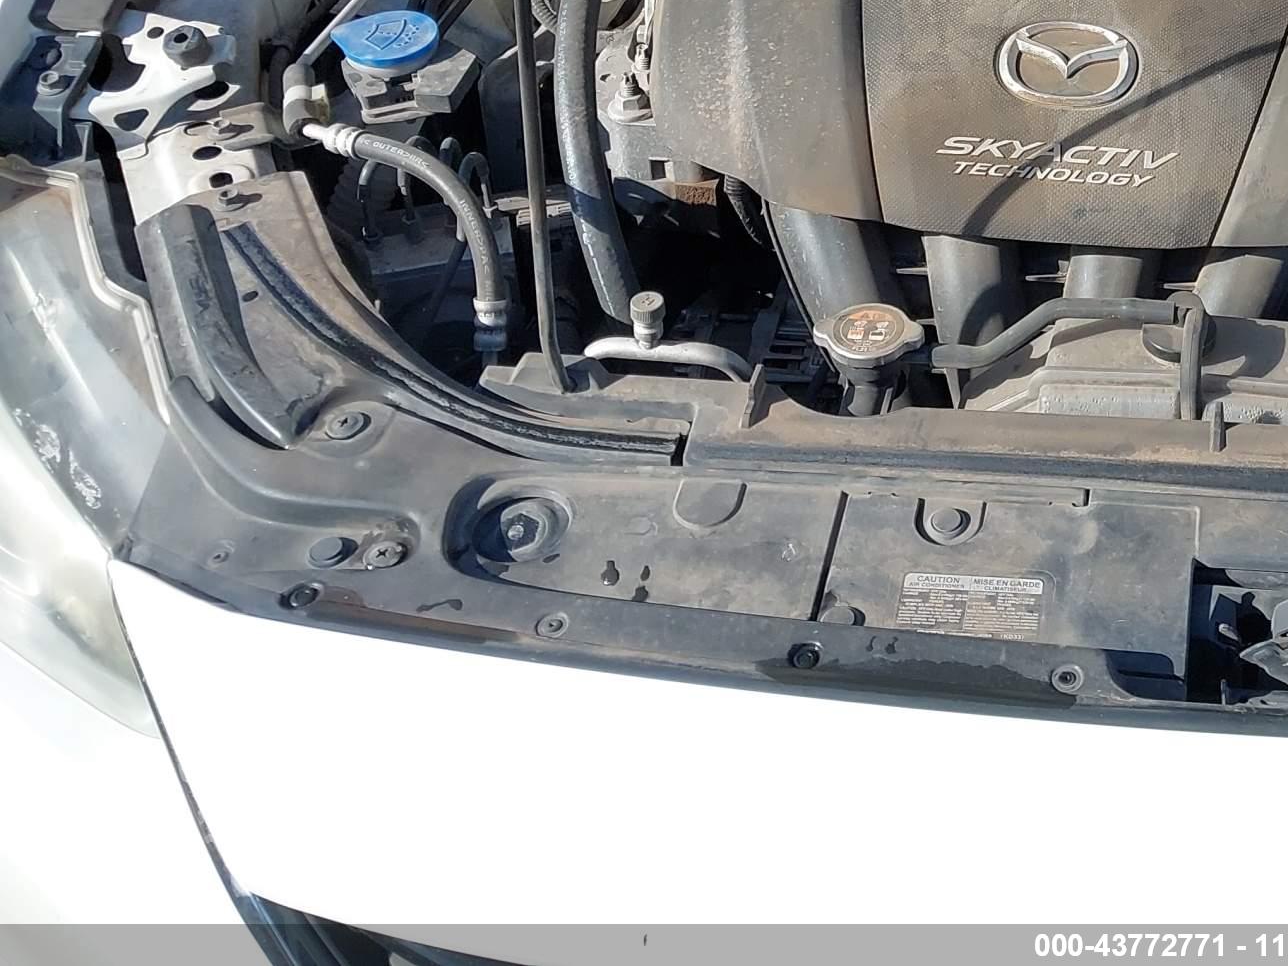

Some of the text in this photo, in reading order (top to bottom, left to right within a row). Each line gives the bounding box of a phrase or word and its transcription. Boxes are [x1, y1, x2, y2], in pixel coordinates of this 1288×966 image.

[936, 136, 1180, 169] SKYACTIV
[953, 161, 1155, 187] TECHNOLOGY
[917, 575, 960, 584] CAUTION
[973, 578, 995, 586] MISE
[1010, 580, 1041, 589] GARDE
